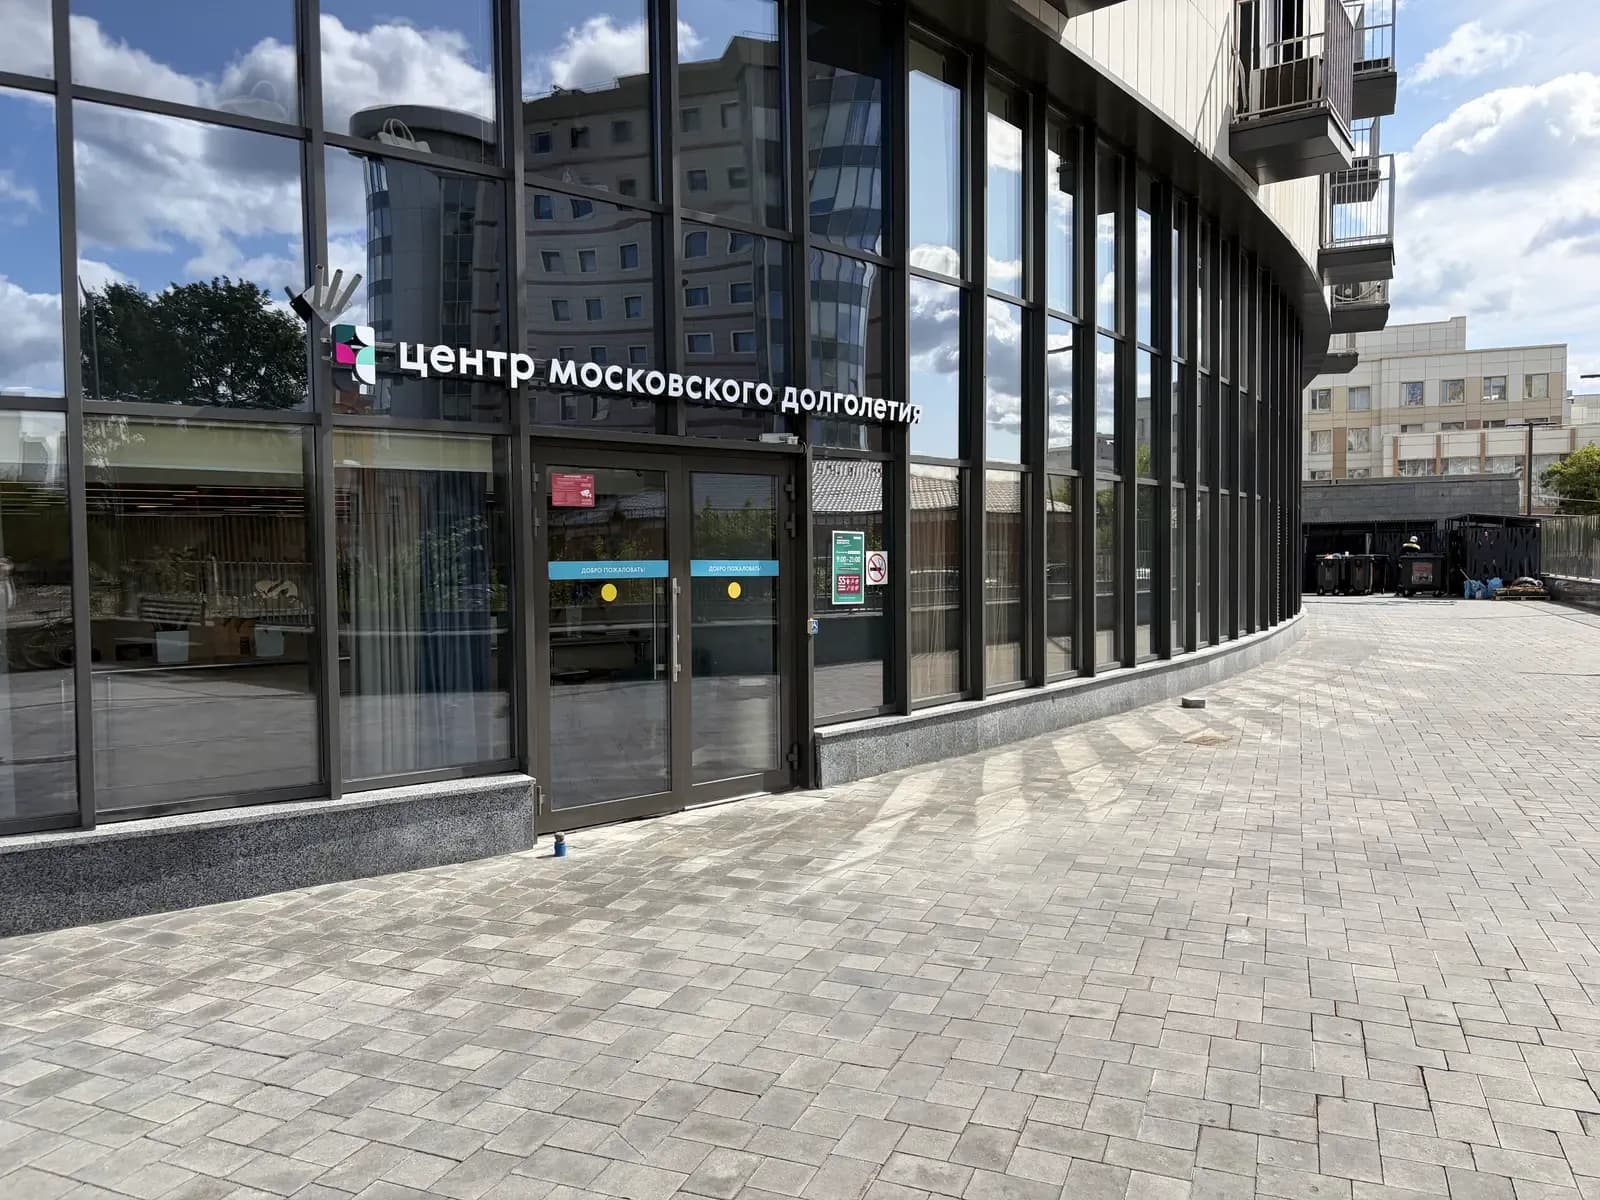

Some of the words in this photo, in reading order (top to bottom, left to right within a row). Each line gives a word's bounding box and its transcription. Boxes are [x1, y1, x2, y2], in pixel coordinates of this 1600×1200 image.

[399, 341, 535, 389] центр
[549, 358, 773, 406] московского
[781, 386, 923, 424] долголетия
